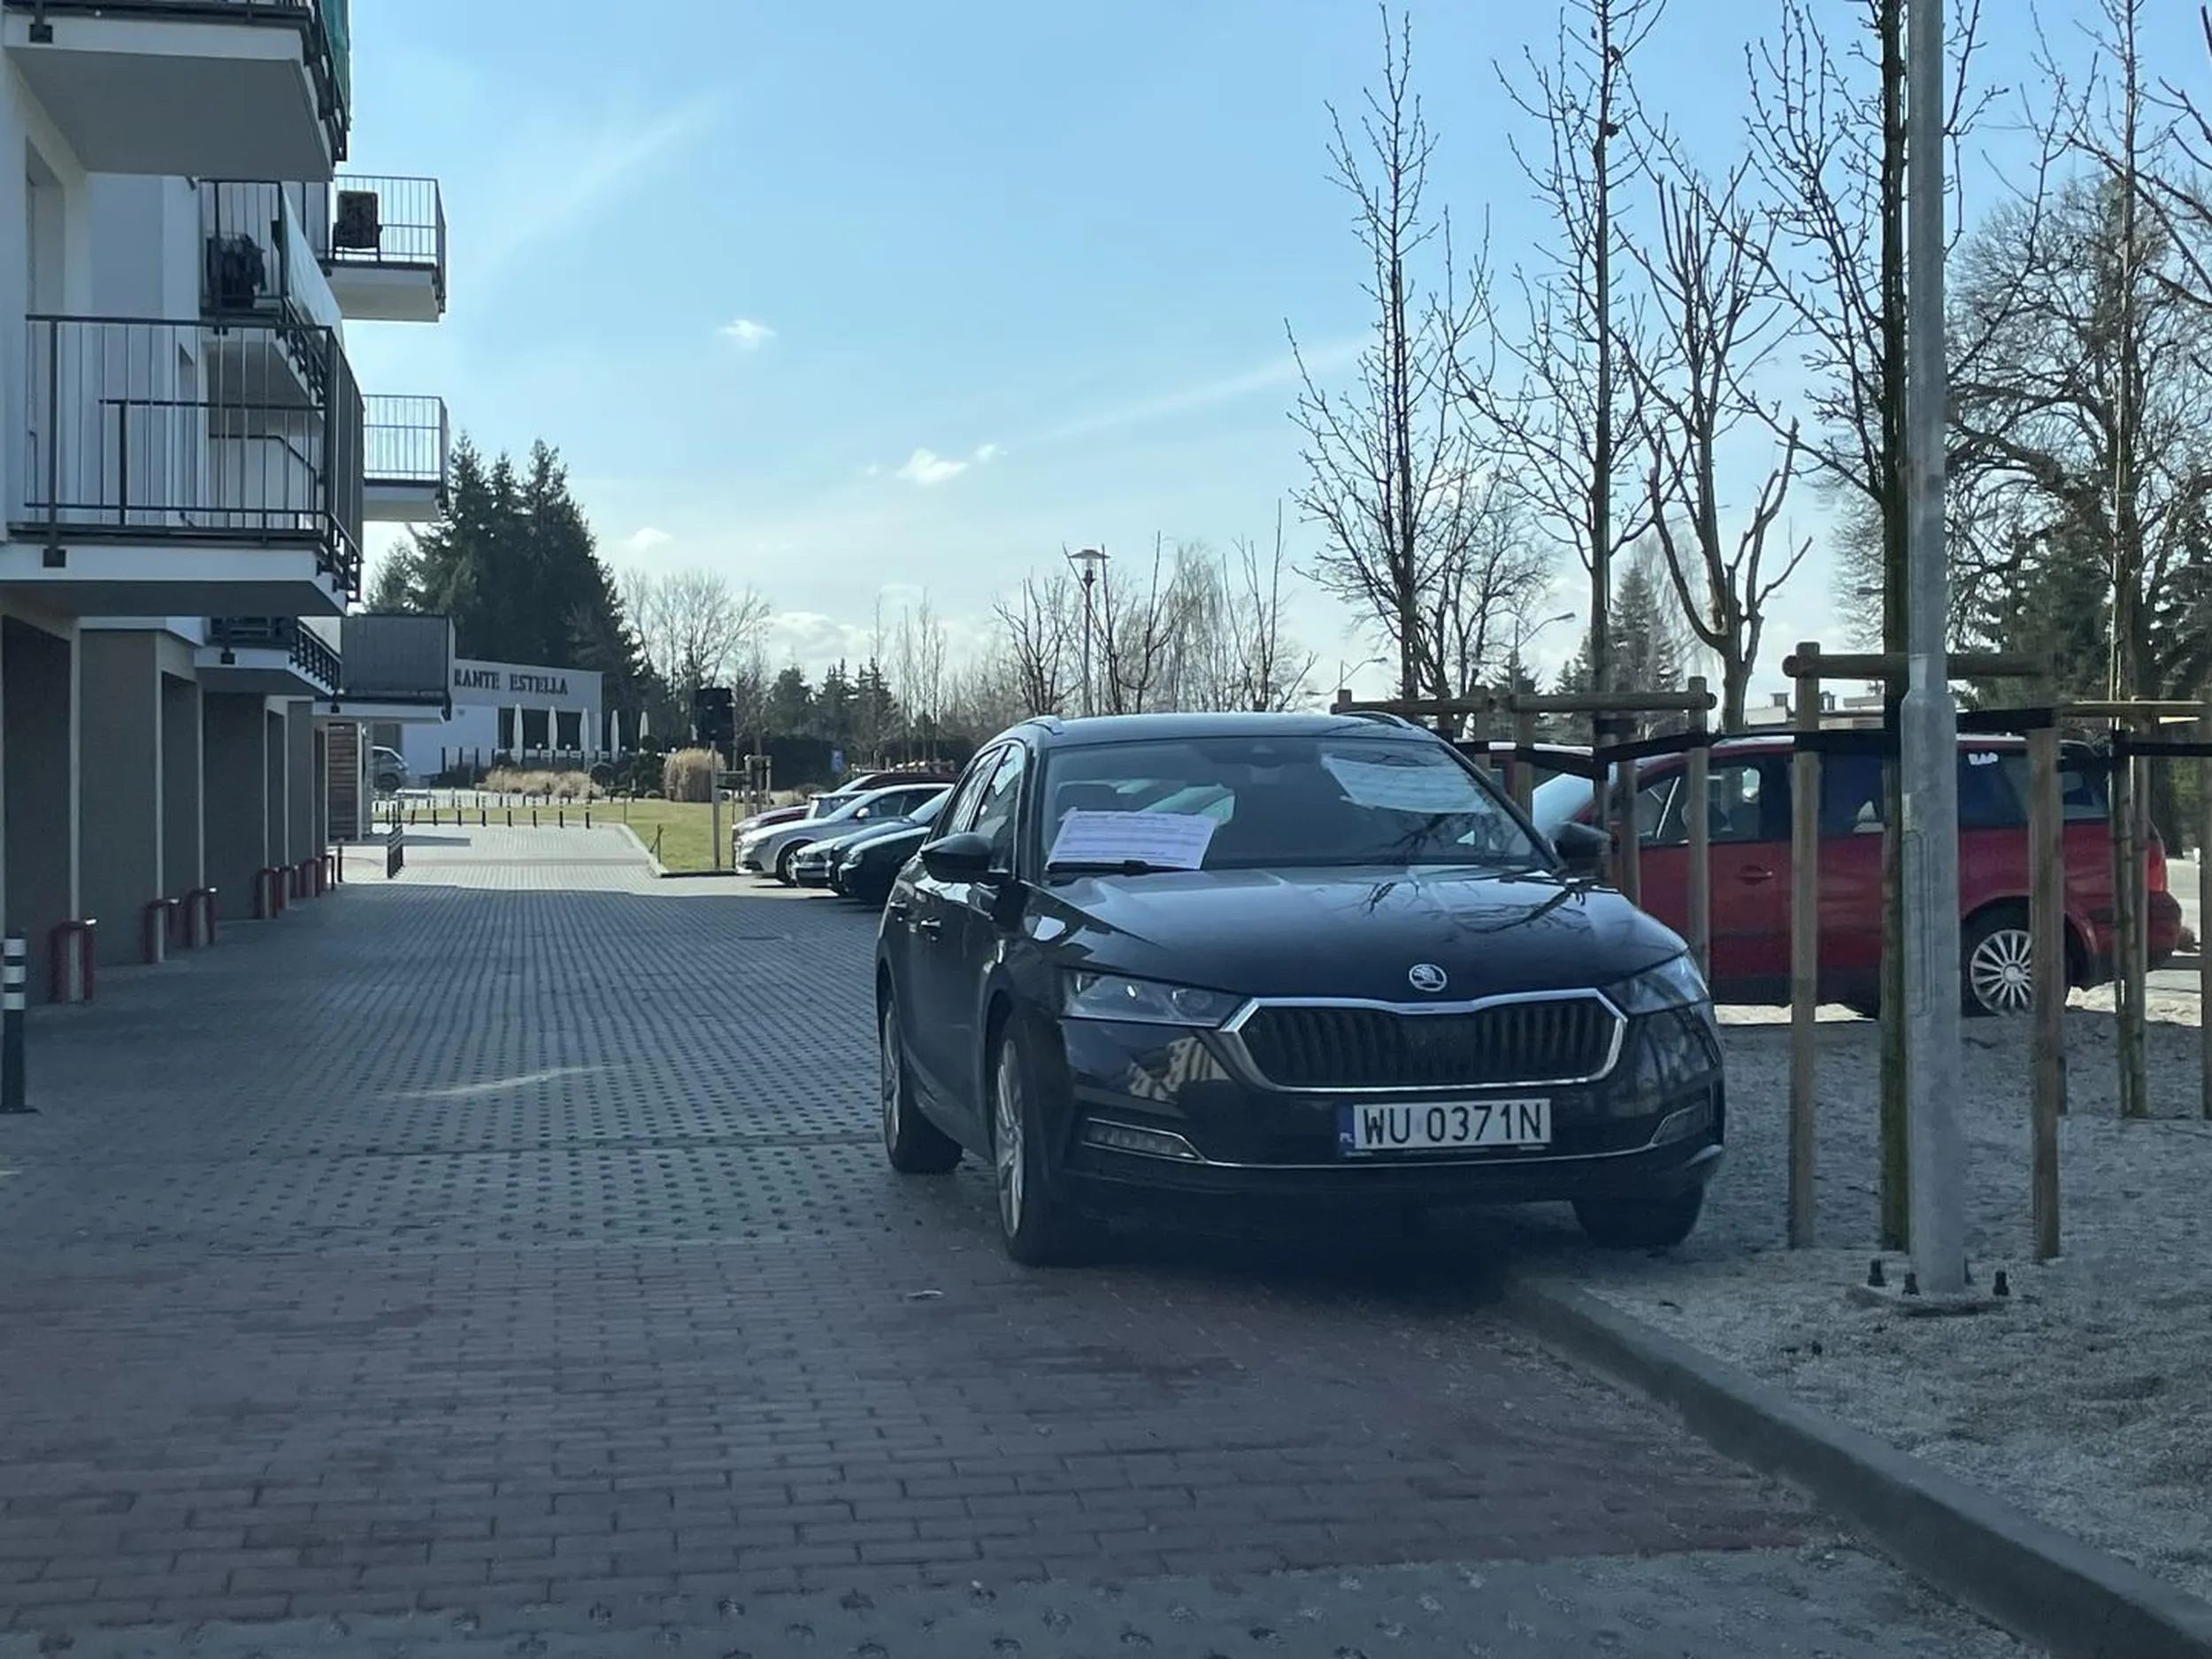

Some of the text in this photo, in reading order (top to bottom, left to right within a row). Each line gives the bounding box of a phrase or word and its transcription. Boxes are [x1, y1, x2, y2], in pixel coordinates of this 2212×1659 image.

[510, 673, 568, 695] ESTELLA
[1363, 1103, 1542, 1145] WU 0371N
